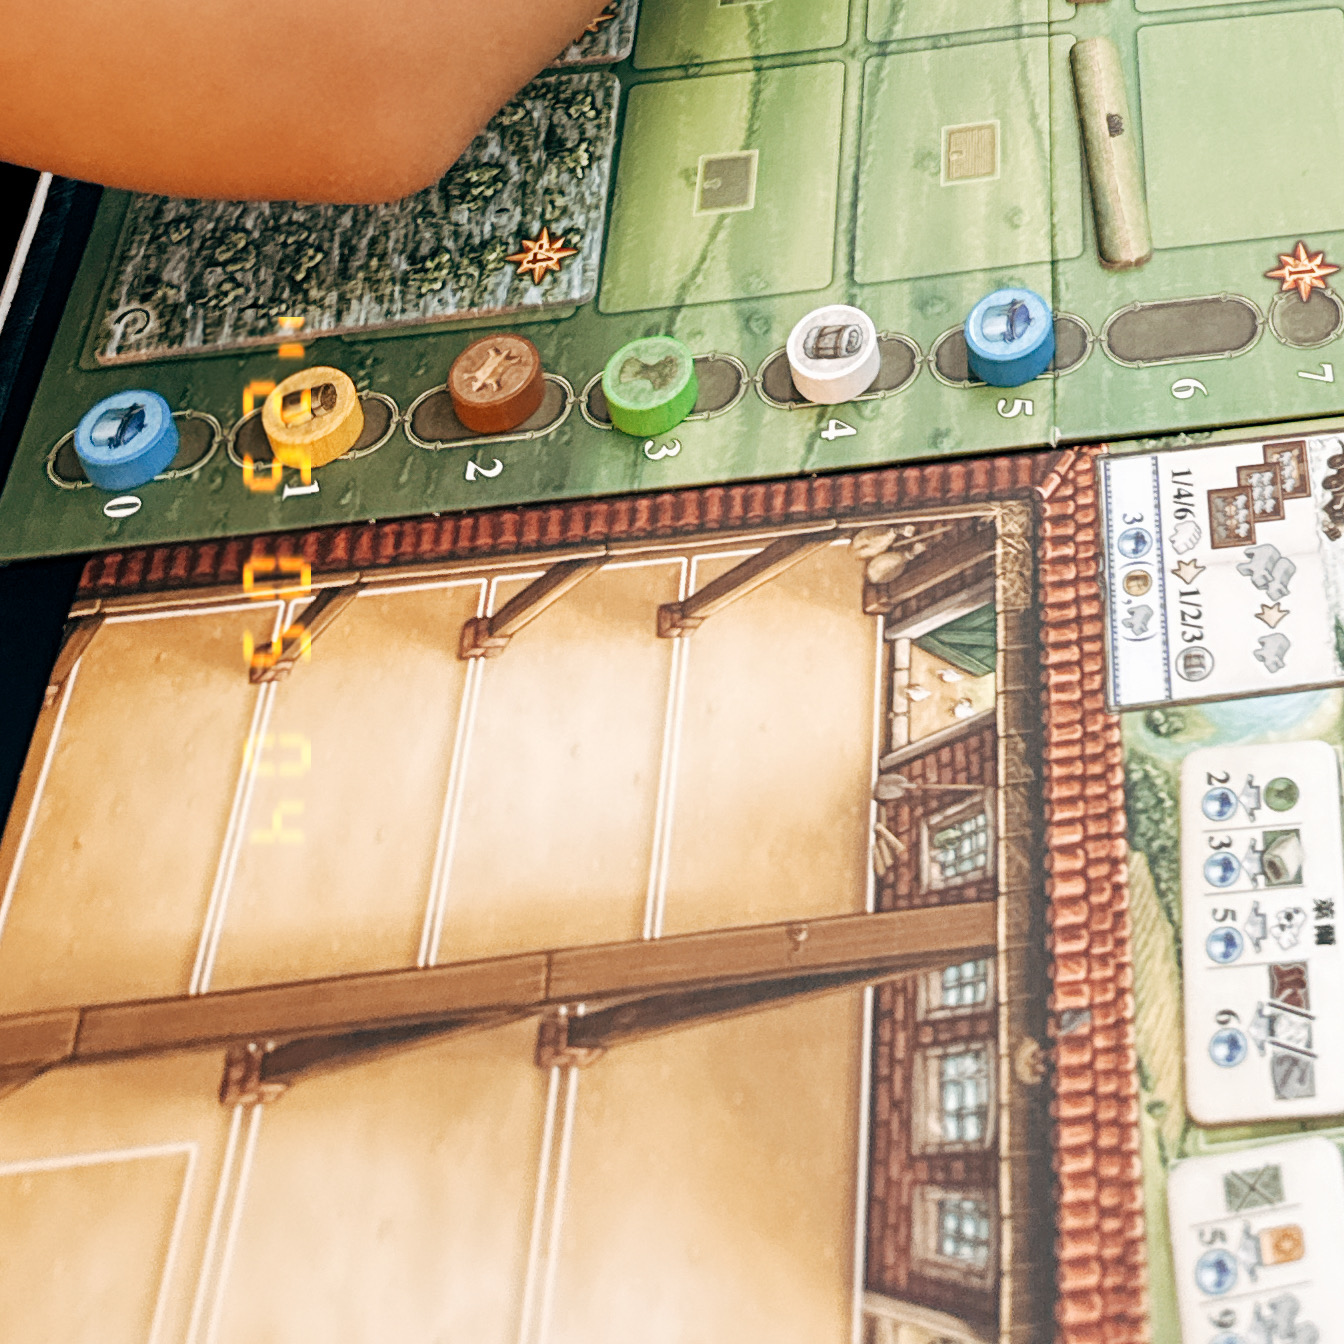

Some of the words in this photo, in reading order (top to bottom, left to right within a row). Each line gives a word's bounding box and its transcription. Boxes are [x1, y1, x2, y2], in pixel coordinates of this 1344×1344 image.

[103, 495, 143, 518] 0
[282, 479, 320, 502] 1
[464, 457, 504, 483] 2
[643, 437, 683, 463] 3
[819, 417, 859, 443] 4
[997, 398, 1036, 420] 5
[1168, 377, 1210, 402] 6
[1298, 363, 1334, 384] 7
[1171, 467, 1197, 520] 1/4/6
[1122, 512, 1144, 525] 3
[1178, 587, 1204, 644] 1/2/3
[1206, 770, 1231, 786] 2
[1208, 835, 1233, 850] 3
[1211, 907, 1237, 923] 5
[1198, 1227, 1228, 1247] 5
